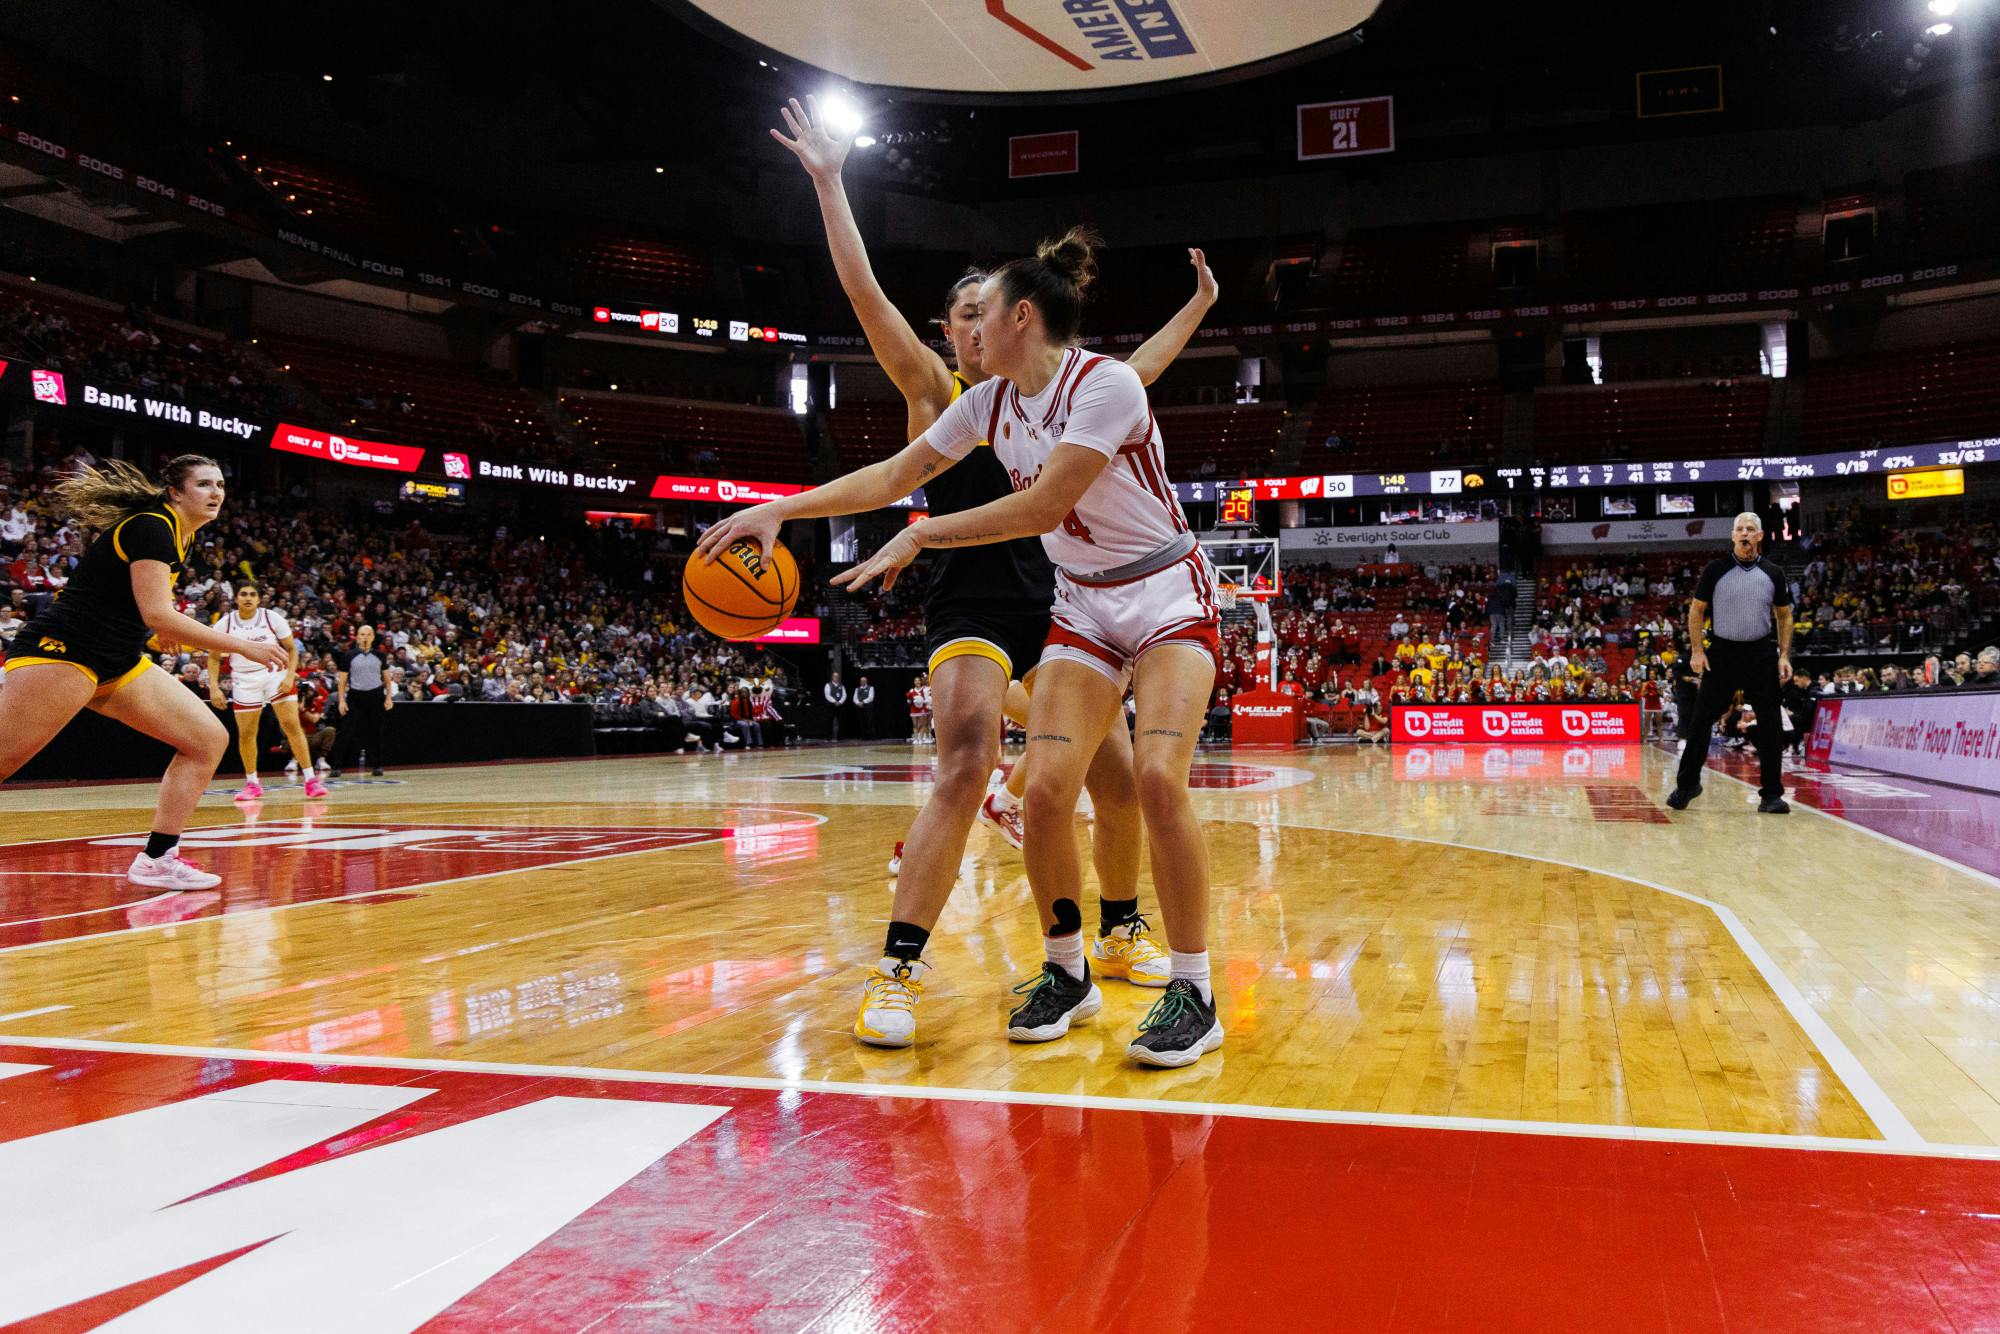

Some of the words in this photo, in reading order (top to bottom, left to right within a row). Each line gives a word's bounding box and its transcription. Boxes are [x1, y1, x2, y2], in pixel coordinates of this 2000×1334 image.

[1062, 0, 1143, 60] AMER
[1329, 107, 1360, 120] HUFF
[1332, 120, 1359, 150] 21
[16, 131, 67, 159] 2000
[79, 154, 124, 180] 2005
[136, 175, 176, 199] 2014
[187, 194, 225, 217] 2015
[277, 228, 320, 254] MEN'S
[321, 245, 357, 267] FINAL
[361, 259, 405, 278] FOUR
[417, 272, 452, 289] 1941
[462, 282, 501, 299] 2000
[508, 292, 542, 308] 2014
[1861, 273, 1904, 289] 2020
[1912, 265, 1959, 282] 2022
[610, 312, 642, 323] TOYOTA
[692, 317, 719, 330] 1:48
[778, 332, 807, 343] TOYOTA
[83, 385, 138, 413] Bank
[143, 398, 192, 424] With
[287, 434, 311, 447] ONLY
[311, 440, 324, 450] AT
[1957, 439, 1982, 449] FIELD
[1860, 450, 1878, 458] 3-PT
[1938, 449, 1985, 465] 33/63
[1741, 458, 1762, 466] FREE
[1763, 457, 1797, 465] THROWS
[1836, 460, 1869, 475] 9/19
[1882, 455, 1915, 469] 47%
[479, 461, 523, 480] Bank
[528, 467, 568, 486] With
[1497, 468, 1522, 477] FOULS
[1529, 468, 1545, 476] TOL
[1552, 466, 1567, 474] AST
[1578, 466, 1591, 474] STL
[1602, 465, 1614, 473] TO
[1627, 463, 1643, 471] REB
[1653, 462, 1674, 470] DREB
[1683, 460, 1705, 469] OREB
[1737, 466, 1764, 480] 2/4
[1783, 464, 1815, 477] 50%
[1379, 475, 1406, 486] 1:48
[1439, 477, 1455, 488] 77
[1507, 478, 1514, 488] 1
[1533, 477, 1543, 488] 3
[1550, 474, 1568, 487] 24
[1579, 474, 1589, 485] 4
[1604, 473, 1613, 484] 7
[1628, 471, 1644, 483] 41
[1654, 470, 1671, 482] 32
[1690, 469, 1699, 480] 9
[671, 484, 696, 493] ONLY
[698, 486, 710, 494] AT
[1329, 482, 1346, 492] 50
[1383, 485, 1400, 494] 4TH
[1193, 490, 1202, 500] 4
[1270, 488, 1279, 498] 3
[1231, 489, 1252, 502] 1:48
[1224, 501, 1249, 521] 29
[1336, 527, 1388, 543] Everlight
[1391, 530, 1421, 541] Solar
[1423, 529, 1450, 541] Club
[1591, 711, 1608, 719] uw
[1432, 719, 1463, 727] credit
[1511, 719, 1543, 727] credit
[1591, 718, 1624, 727] credit
[1432, 727, 1464, 736] union
[1511, 727, 1544, 736] union
[1591, 726, 1625, 735] union
[1923, 721, 1951, 760] Hoop
[1952, 720, 1984, 758] There
[1984, 723, 1997, 759] It
